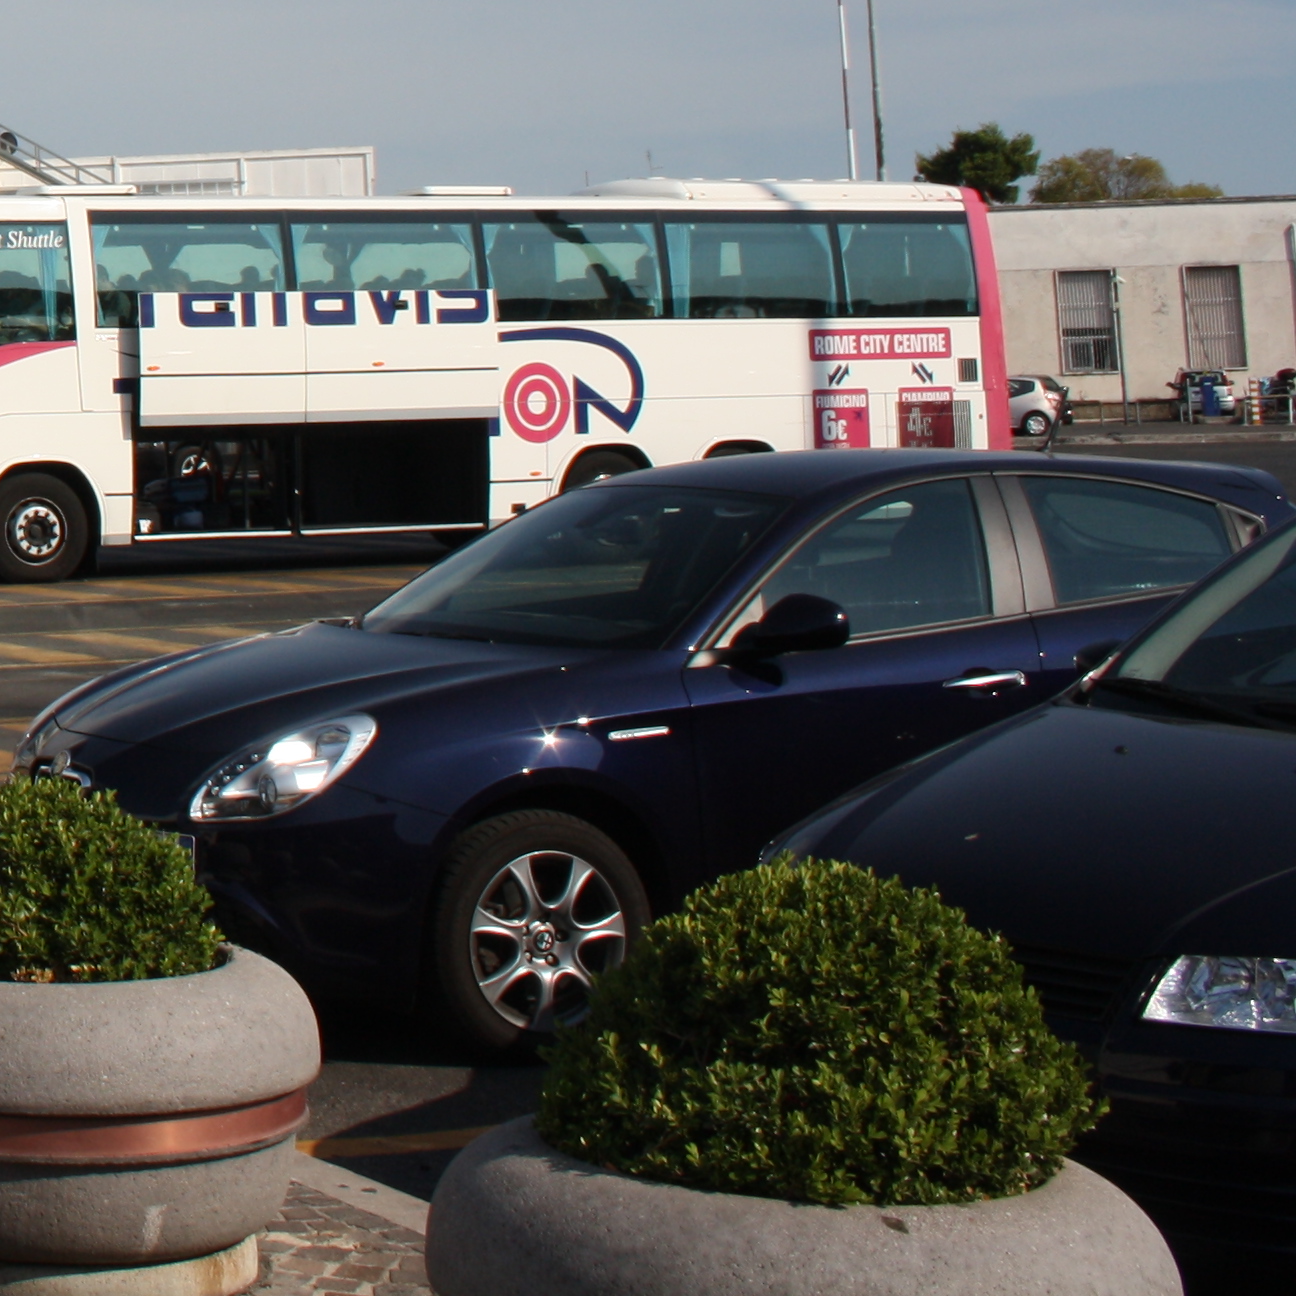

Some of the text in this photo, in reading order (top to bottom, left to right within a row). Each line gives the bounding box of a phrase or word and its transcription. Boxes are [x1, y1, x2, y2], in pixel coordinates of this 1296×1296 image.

[6, 231, 63, 249] Shuttle
[814, 333, 946, 355] ROME CITY CENTRE
[815, 394, 867, 408] FIUMICINO
[821, 409, 848, 441] 6€
